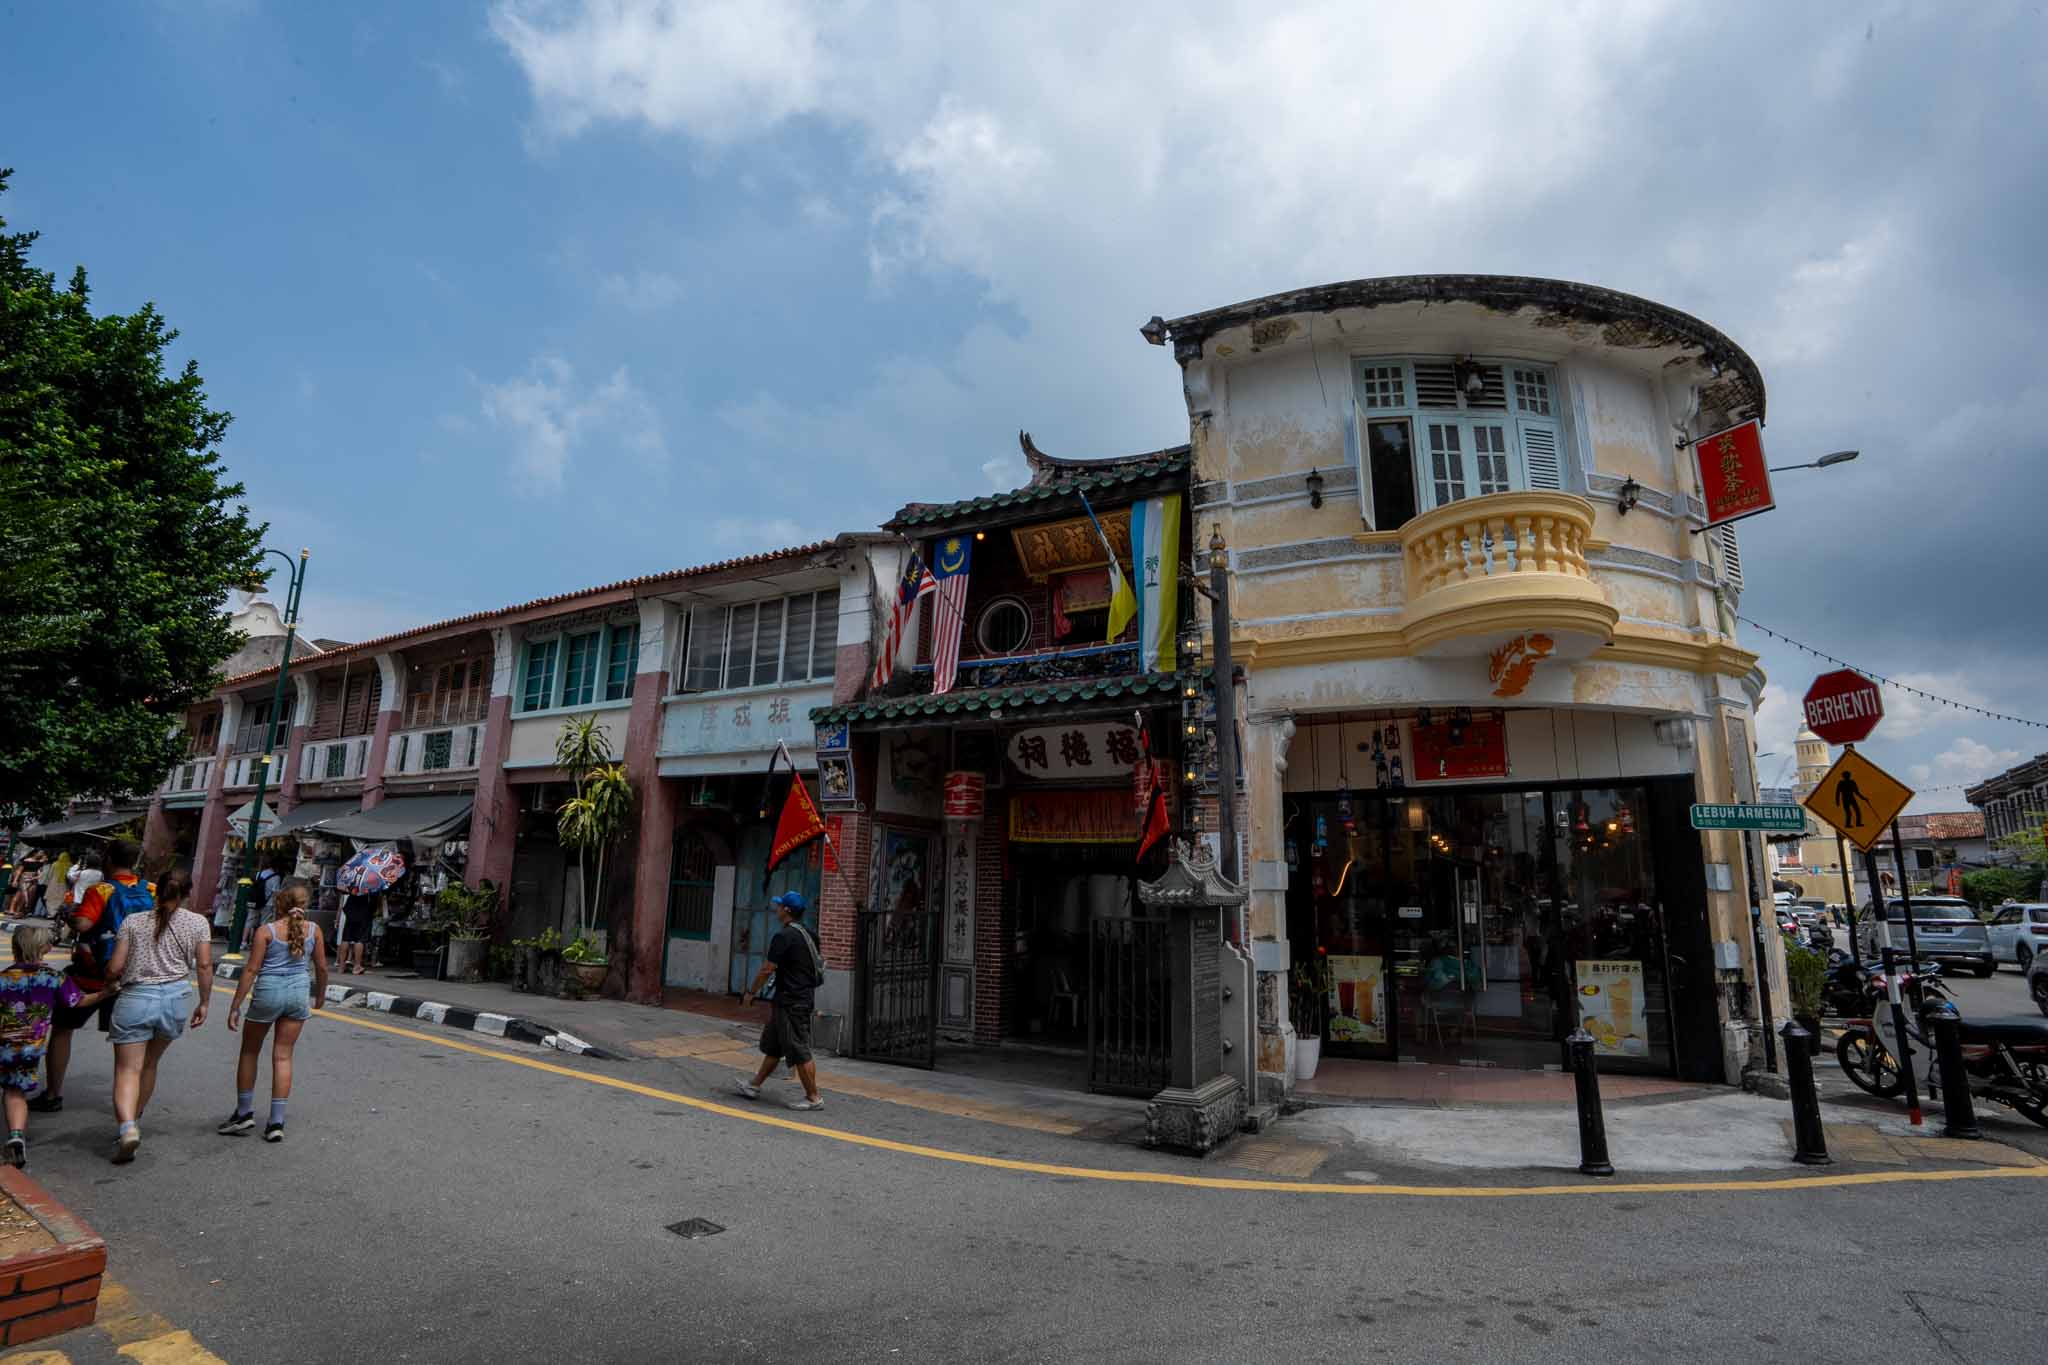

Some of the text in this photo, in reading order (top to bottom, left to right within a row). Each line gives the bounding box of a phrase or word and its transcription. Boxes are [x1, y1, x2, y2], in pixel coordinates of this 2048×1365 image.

[1807, 687, 1879, 728] BERHENTI
[1696, 807, 1801, 819] LEBUH ARMENIAN
